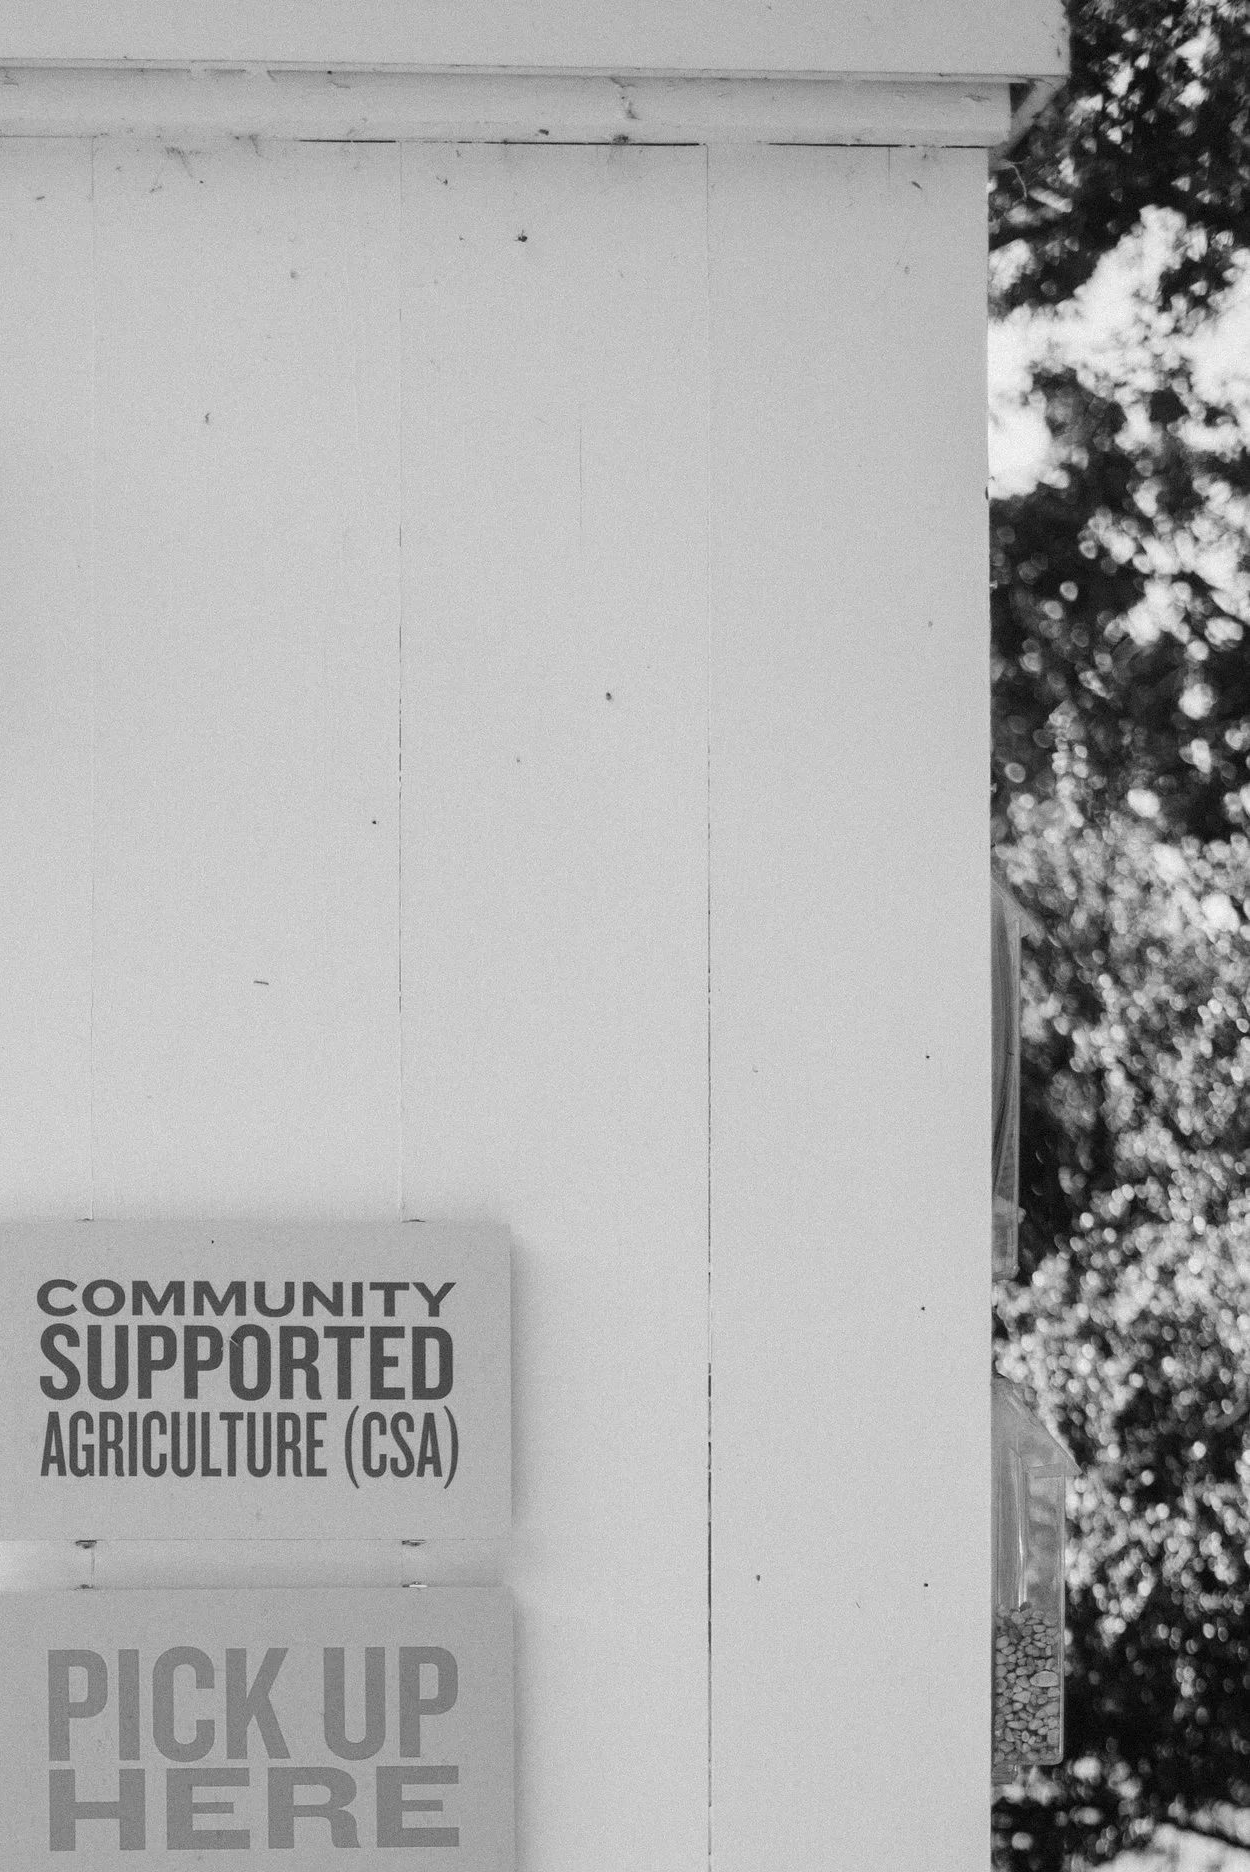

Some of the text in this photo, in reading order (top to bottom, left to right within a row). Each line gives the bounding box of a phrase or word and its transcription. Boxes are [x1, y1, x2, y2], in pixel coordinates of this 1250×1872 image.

[36, 1278, 457, 1318] COMMUNITY
[39, 1322, 454, 1402] SUPPORTED
[40, 1405, 460, 1490] AGRICULTURE (CSA)
[47, 1645, 459, 1763] PICK UP
[48, 1764, 461, 1853] HERE
